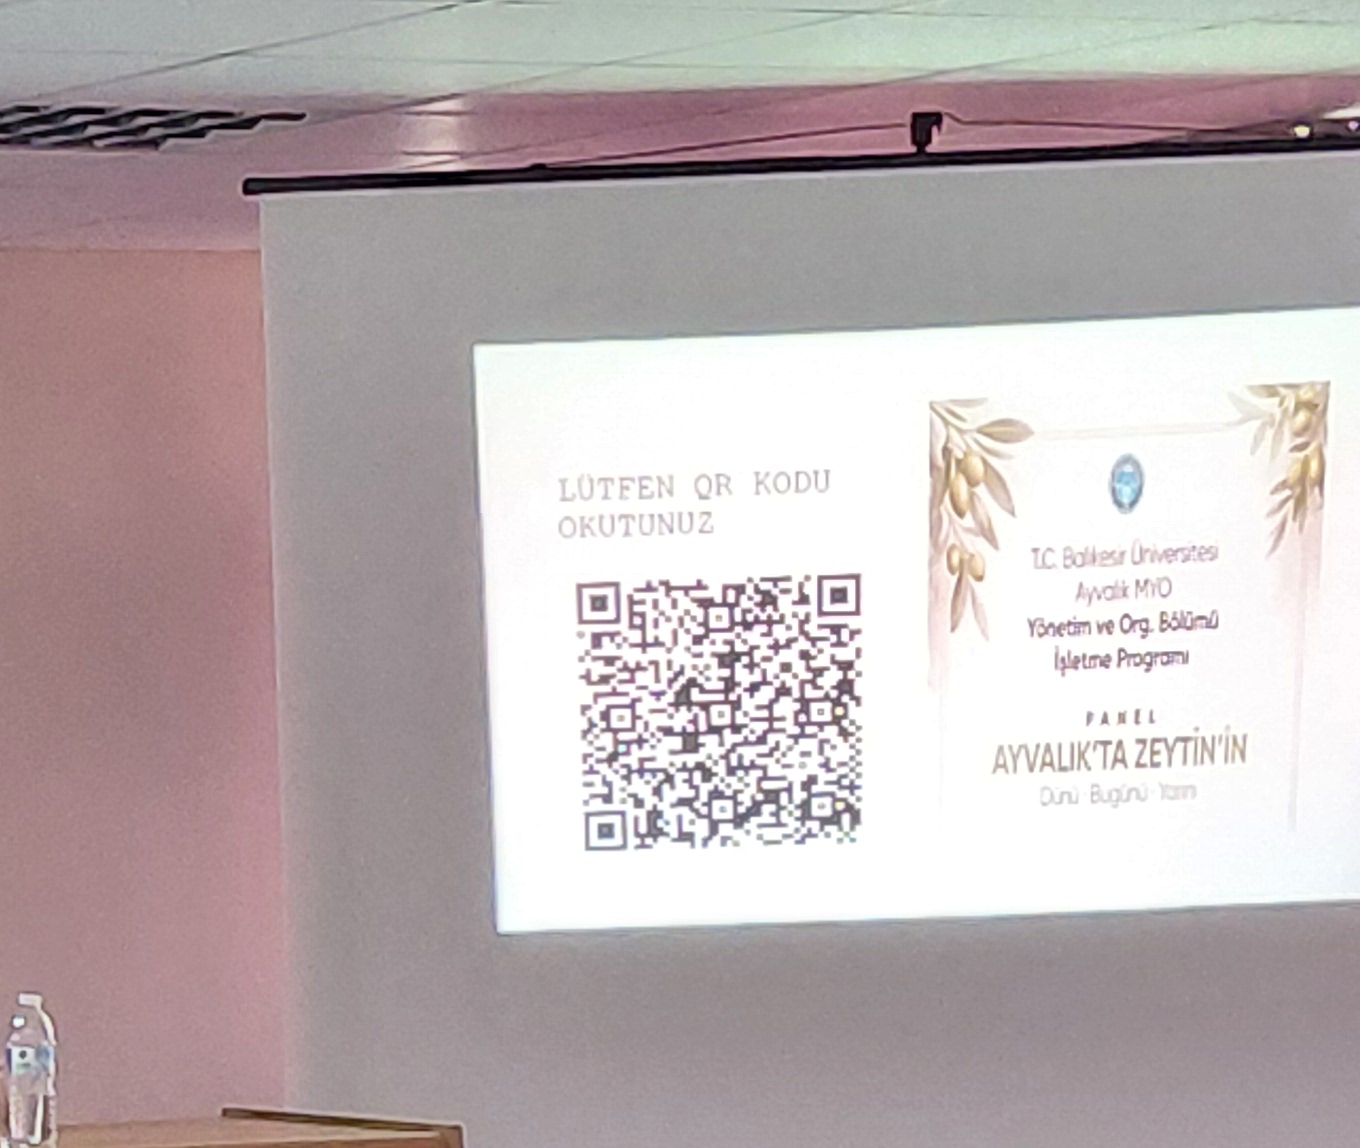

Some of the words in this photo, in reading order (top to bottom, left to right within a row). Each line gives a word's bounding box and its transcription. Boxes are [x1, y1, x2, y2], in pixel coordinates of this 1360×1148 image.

[558, 474, 675, 502] LÜTFEN
[693, 473, 732, 500] QR
[753, 469, 831, 496] KODU
[557, 511, 715, 539] OKUTUNUZ
[1027, 616, 1092, 638] Yönetim
[1096, 619, 1115, 636] ve
[1119, 613, 1155, 639] Org.
[1159, 609, 1220, 633] Bölümü
[1085, 708, 1156, 727] PANEL
